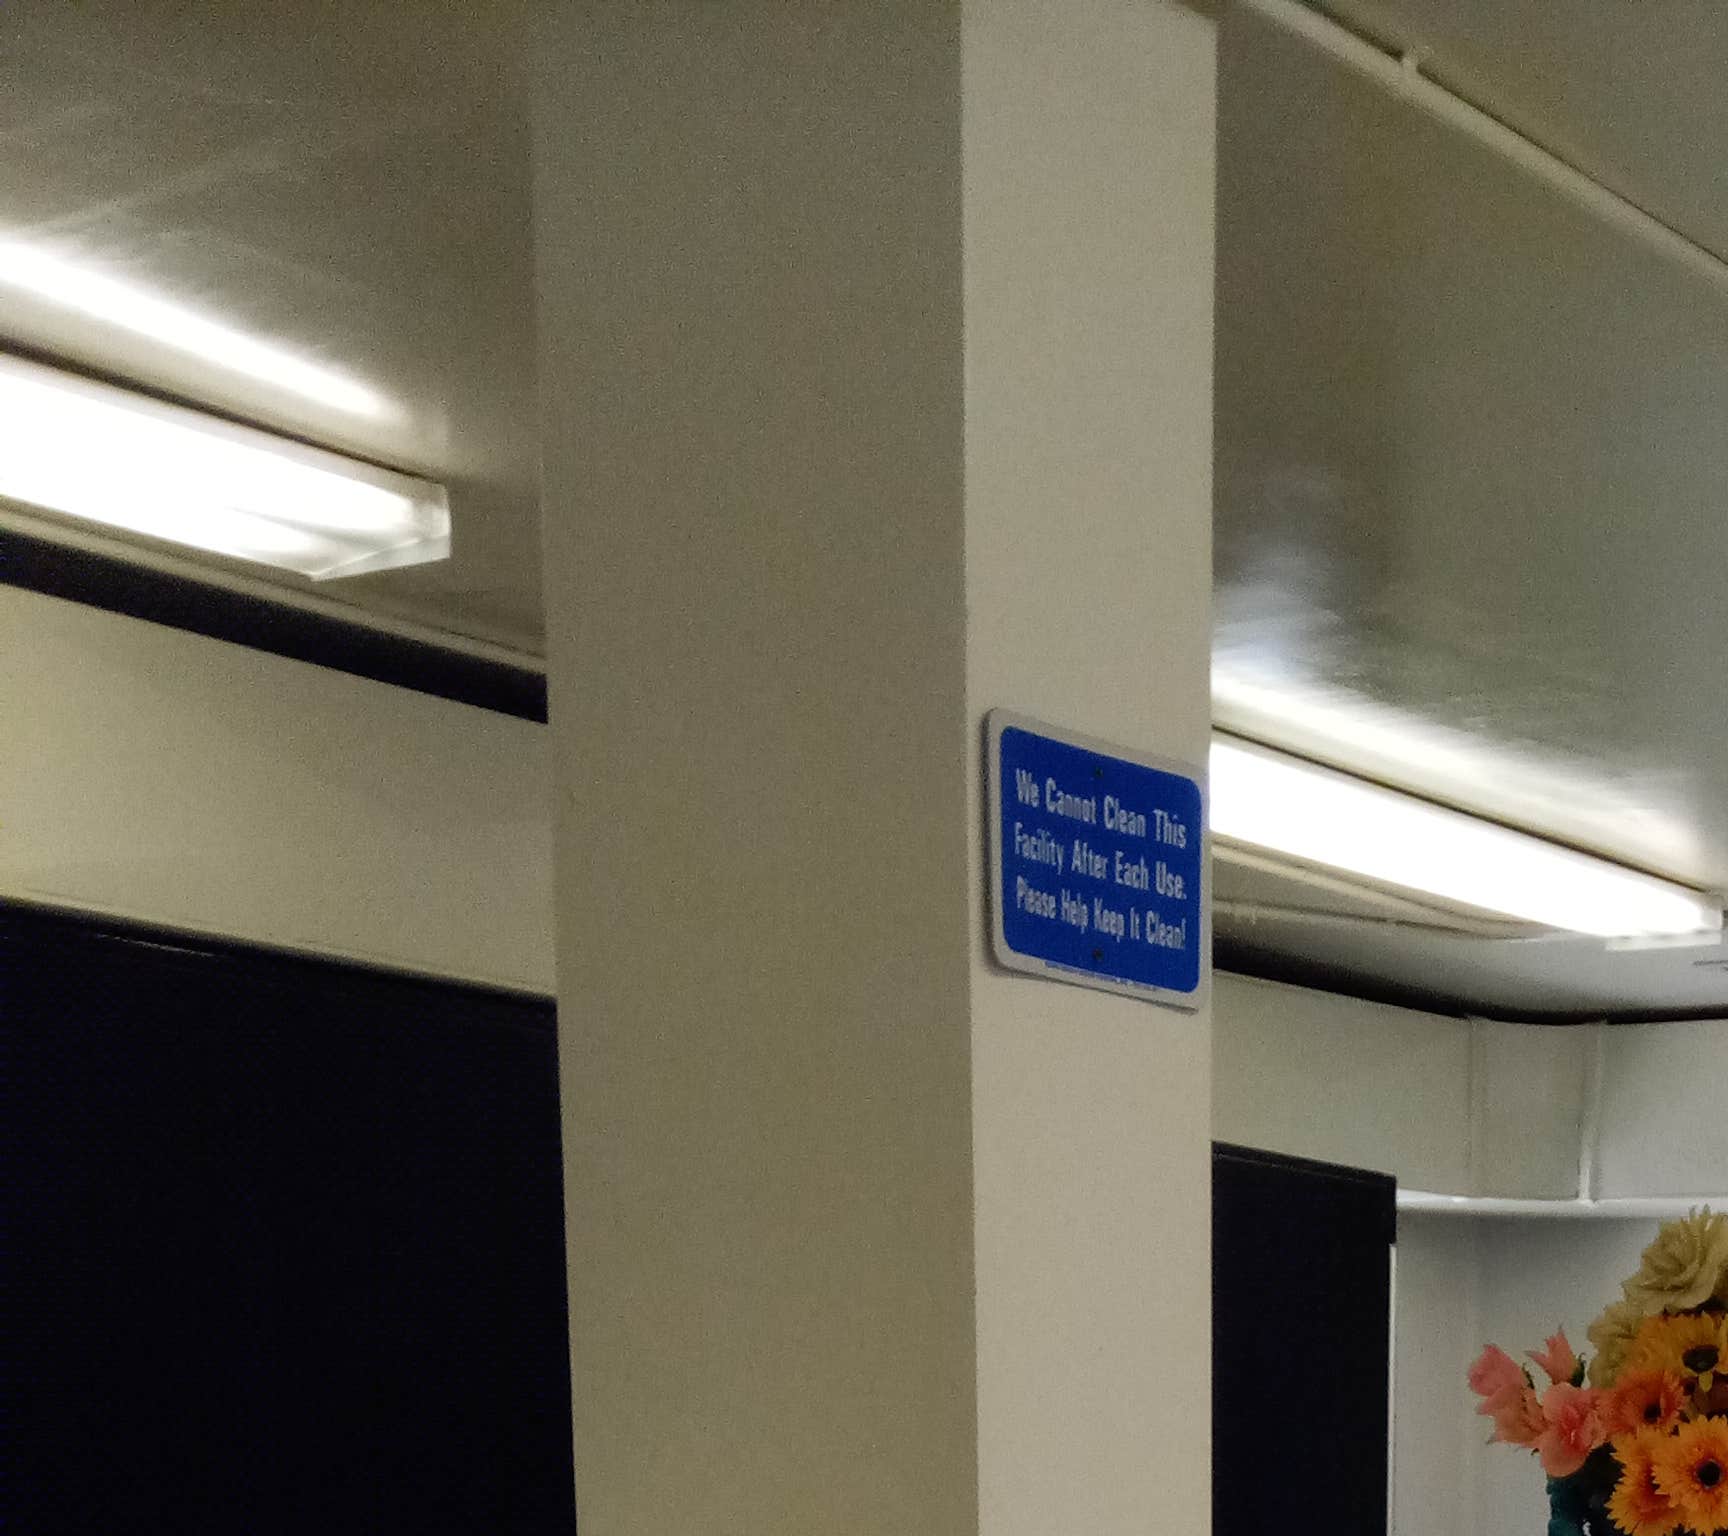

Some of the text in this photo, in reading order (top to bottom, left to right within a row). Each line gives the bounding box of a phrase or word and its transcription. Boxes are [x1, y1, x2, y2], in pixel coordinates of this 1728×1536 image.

[1015, 767, 1187, 849] We Cannot Clean This
[1014, 821, 1187, 900] Facility After Each Use.
[1016, 874, 1187, 950] Please Help Keep It Clean!
